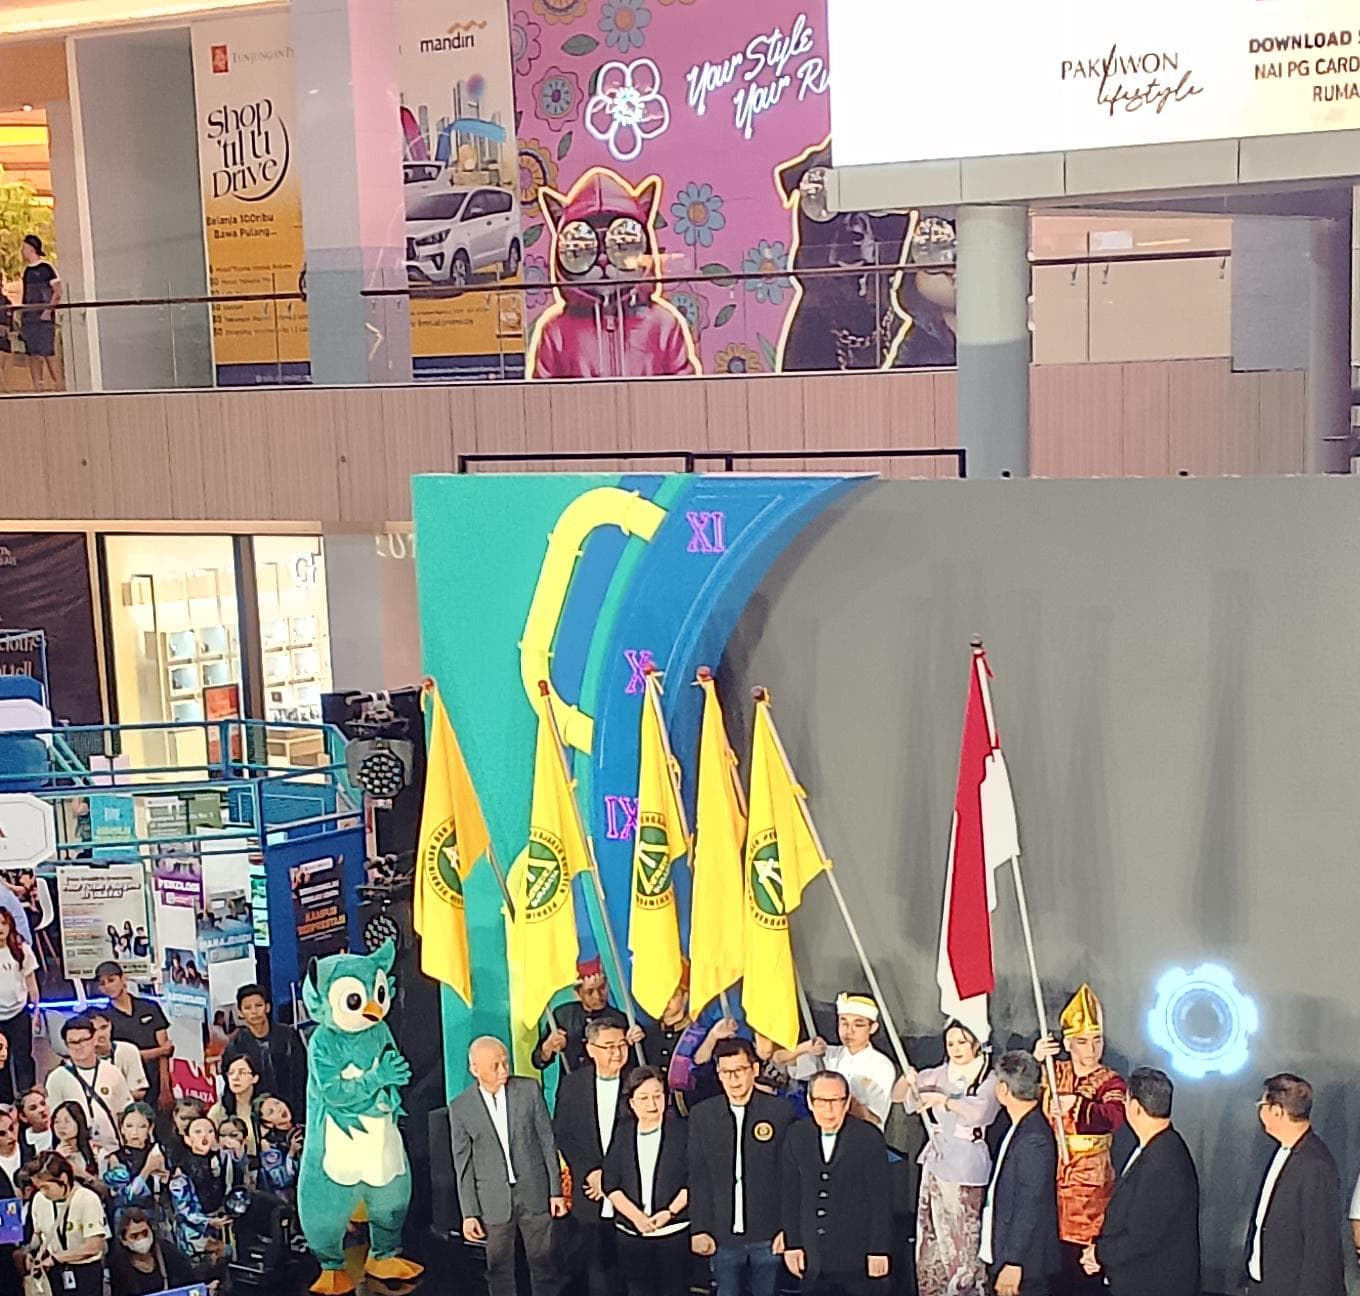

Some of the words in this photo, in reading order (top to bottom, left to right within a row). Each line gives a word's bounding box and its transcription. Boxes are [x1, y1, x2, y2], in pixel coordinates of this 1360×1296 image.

[420, 32, 474, 52] mandiri
[1249, 30, 1352, 54] DOWNLOAD
[686, 53, 744, 115] Your
[744, 14, 814, 80] Style
[1061, 50, 1180, 81] PAKUWON
[1254, 63, 1283, 81] NAI
[1288, 61, 1310, 79] PG
[208, 99, 273, 139] Shop
[733, 75, 791, 139] Your
[213, 158, 277, 198] Drive
[686, 512, 726, 555] XI
